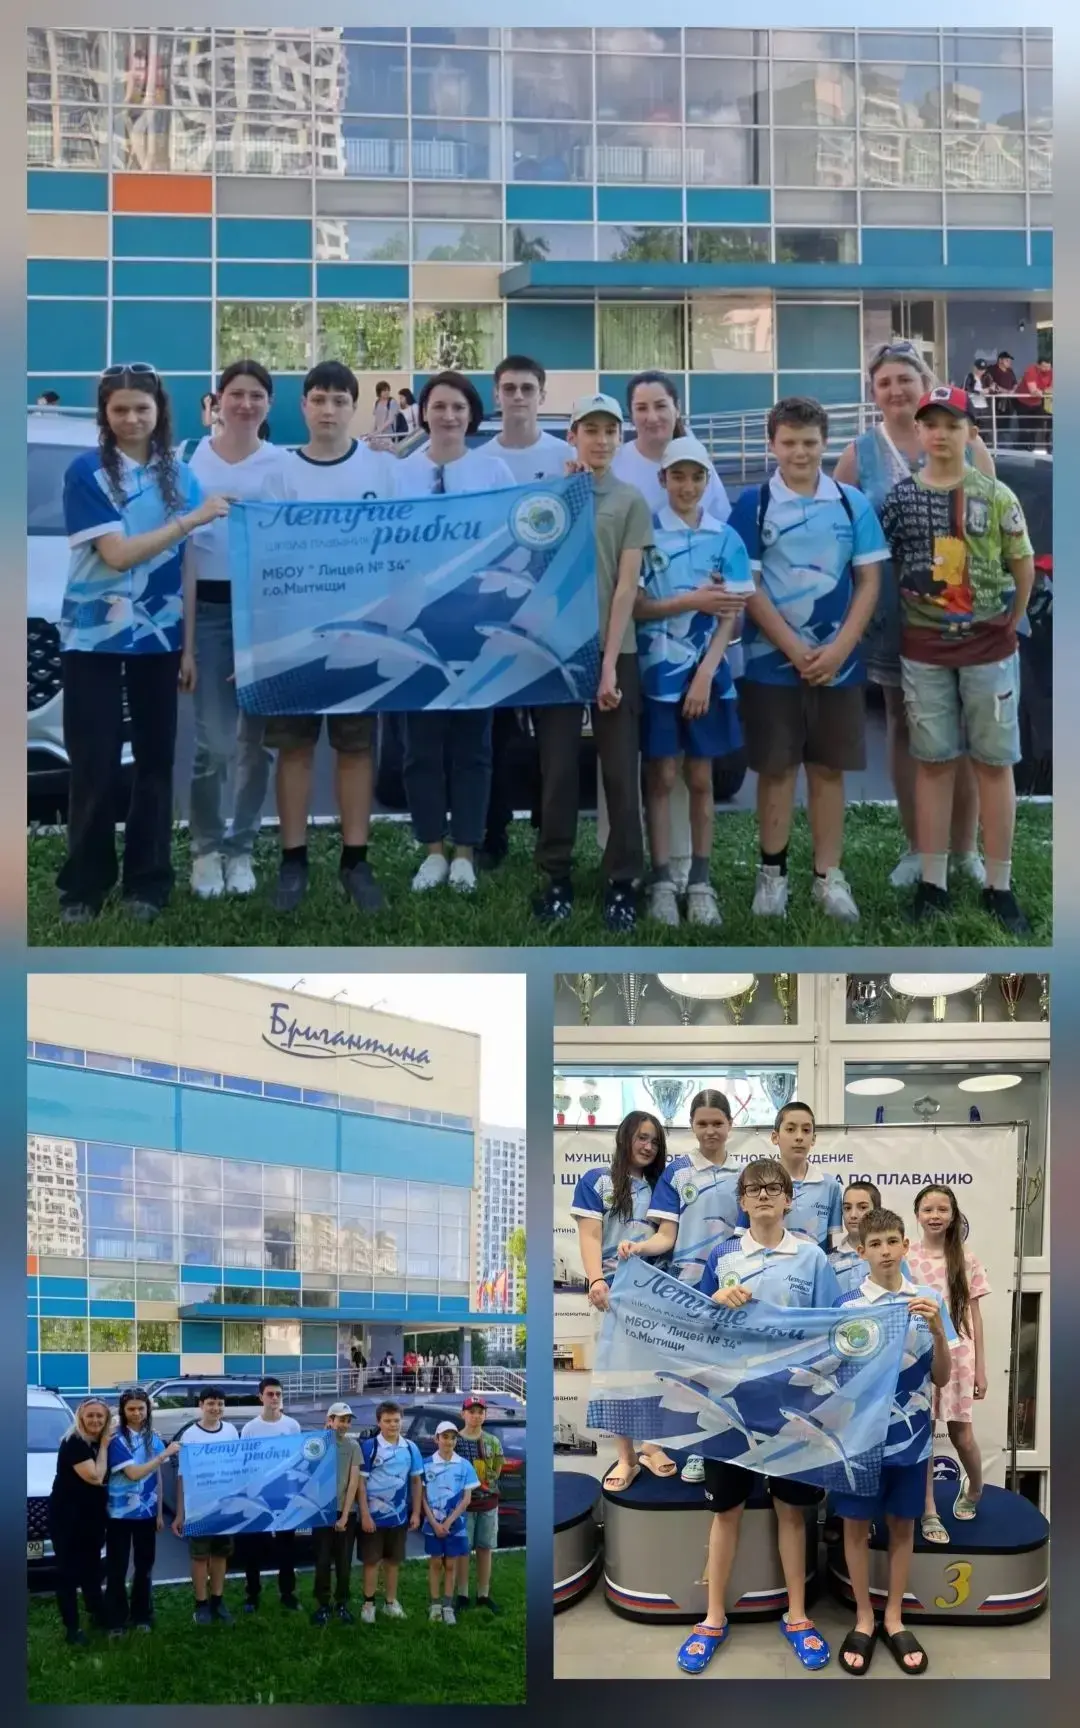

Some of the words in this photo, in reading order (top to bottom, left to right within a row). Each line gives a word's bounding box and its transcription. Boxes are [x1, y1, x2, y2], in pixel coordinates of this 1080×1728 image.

[258, 503, 414, 533] Летучие
[370, 514, 482, 555] рыбки
[262, 566, 304, 580] МБОУ
[318, 562, 364, 576] Лицей
[368, 562, 385, 574] №
[270, 1003, 431, 1064] Бригантина
[848, 1174, 872, 1185] ПО
[876, 1173, 974, 1185] ПЛАВАНИЮ
[633, 1273, 748, 1326] Летучие
[625, 1315, 660, 1330] МБОУ
[667, 1326, 705, 1341] Лицей
[706, 1335, 721, 1345] №
[625, 1328, 685, 1351] г.о.Мытищи
[935, 1562, 973, 1610] 3
